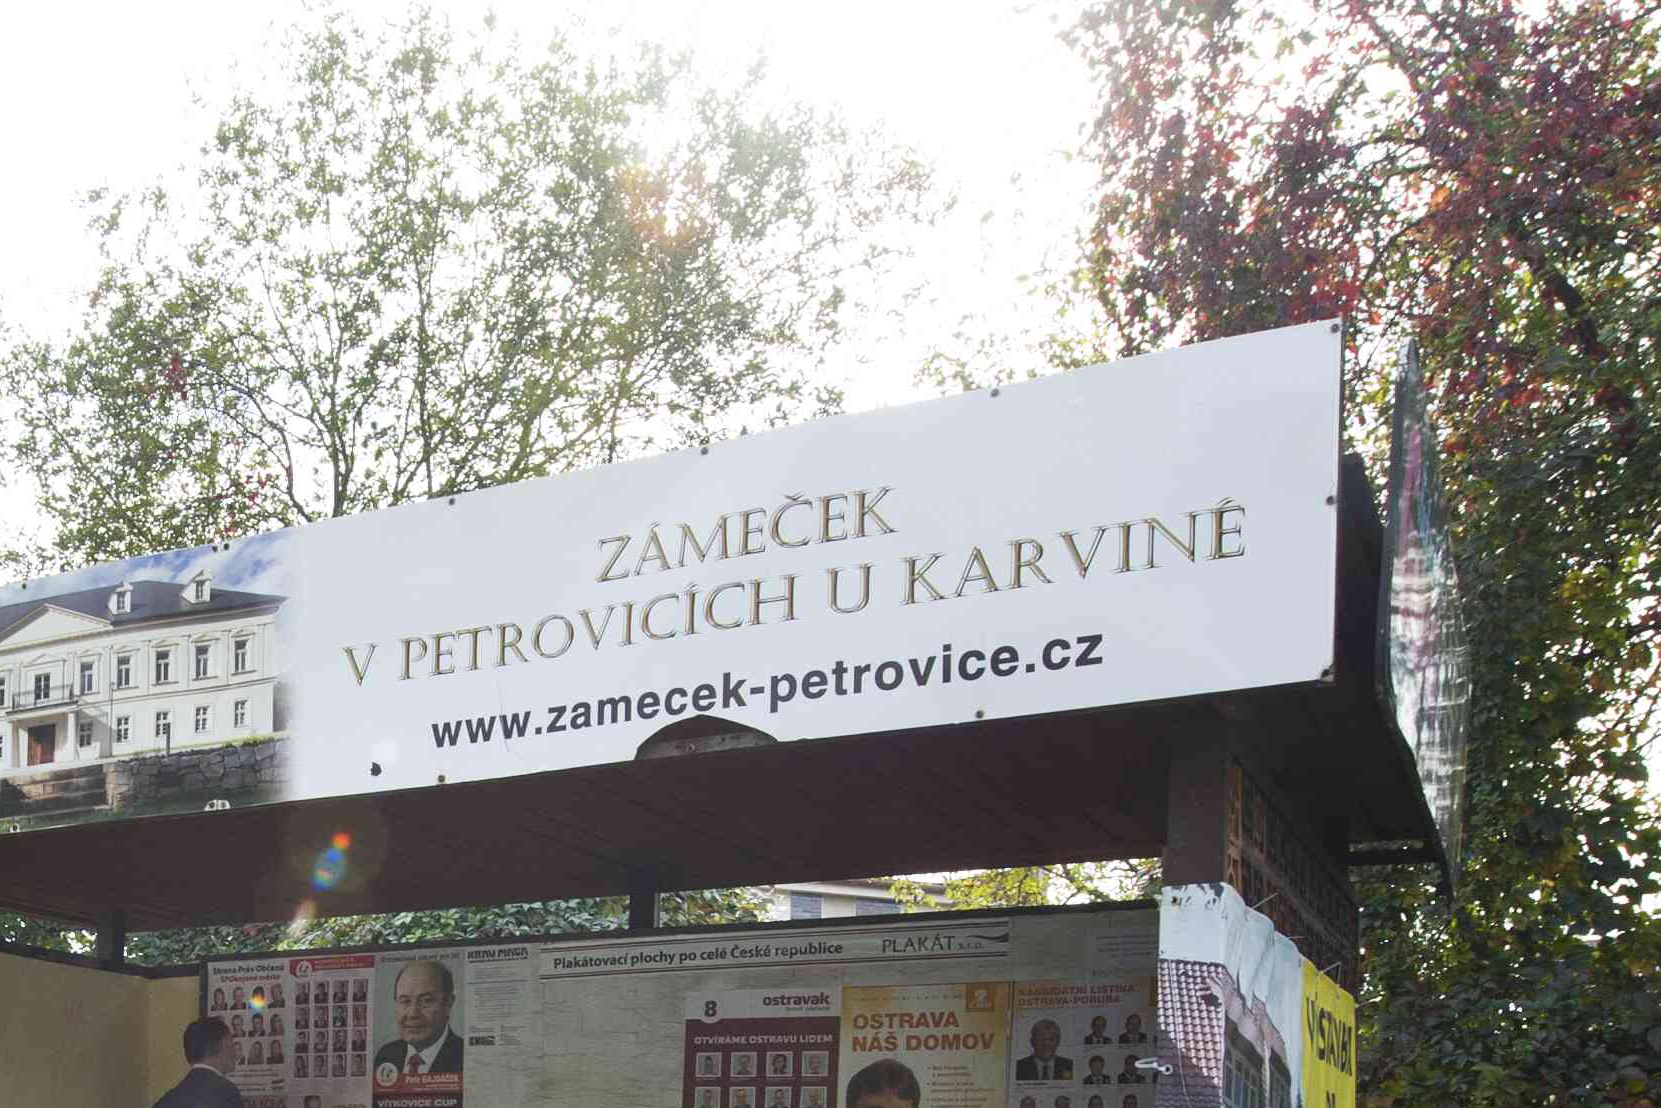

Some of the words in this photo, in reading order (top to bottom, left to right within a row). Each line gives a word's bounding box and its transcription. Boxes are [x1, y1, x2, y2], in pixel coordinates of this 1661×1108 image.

[597, 484, 896, 583] ZÁMEČEK
[344, 645, 379, 686] V
[397, 573, 797, 682] PETROVICÍCH
[825, 563, 875, 616] U
[900, 496, 1248, 606] KARVINÉ
[431, 632, 1105, 748] www.zamecek-petrovice.cz
[882, 933, 956, 954] PLAKÁT
[553, 950, 629, 970] Plakátovací
[630, 948, 676, 967] plochy
[678, 951, 697, 966] po
[700, 945, 727, 961] celé
[730, 943, 771, 960] České
[774, 942, 843, 960] republice
[704, 1000, 717, 1017] 8
[763, 992, 830, 1006] ostravak
[852, 1011, 960, 1030] OSTRAVA
[852, 1031, 899, 1052] NÁŠ
[906, 1032, 996, 1051] DOMOV
